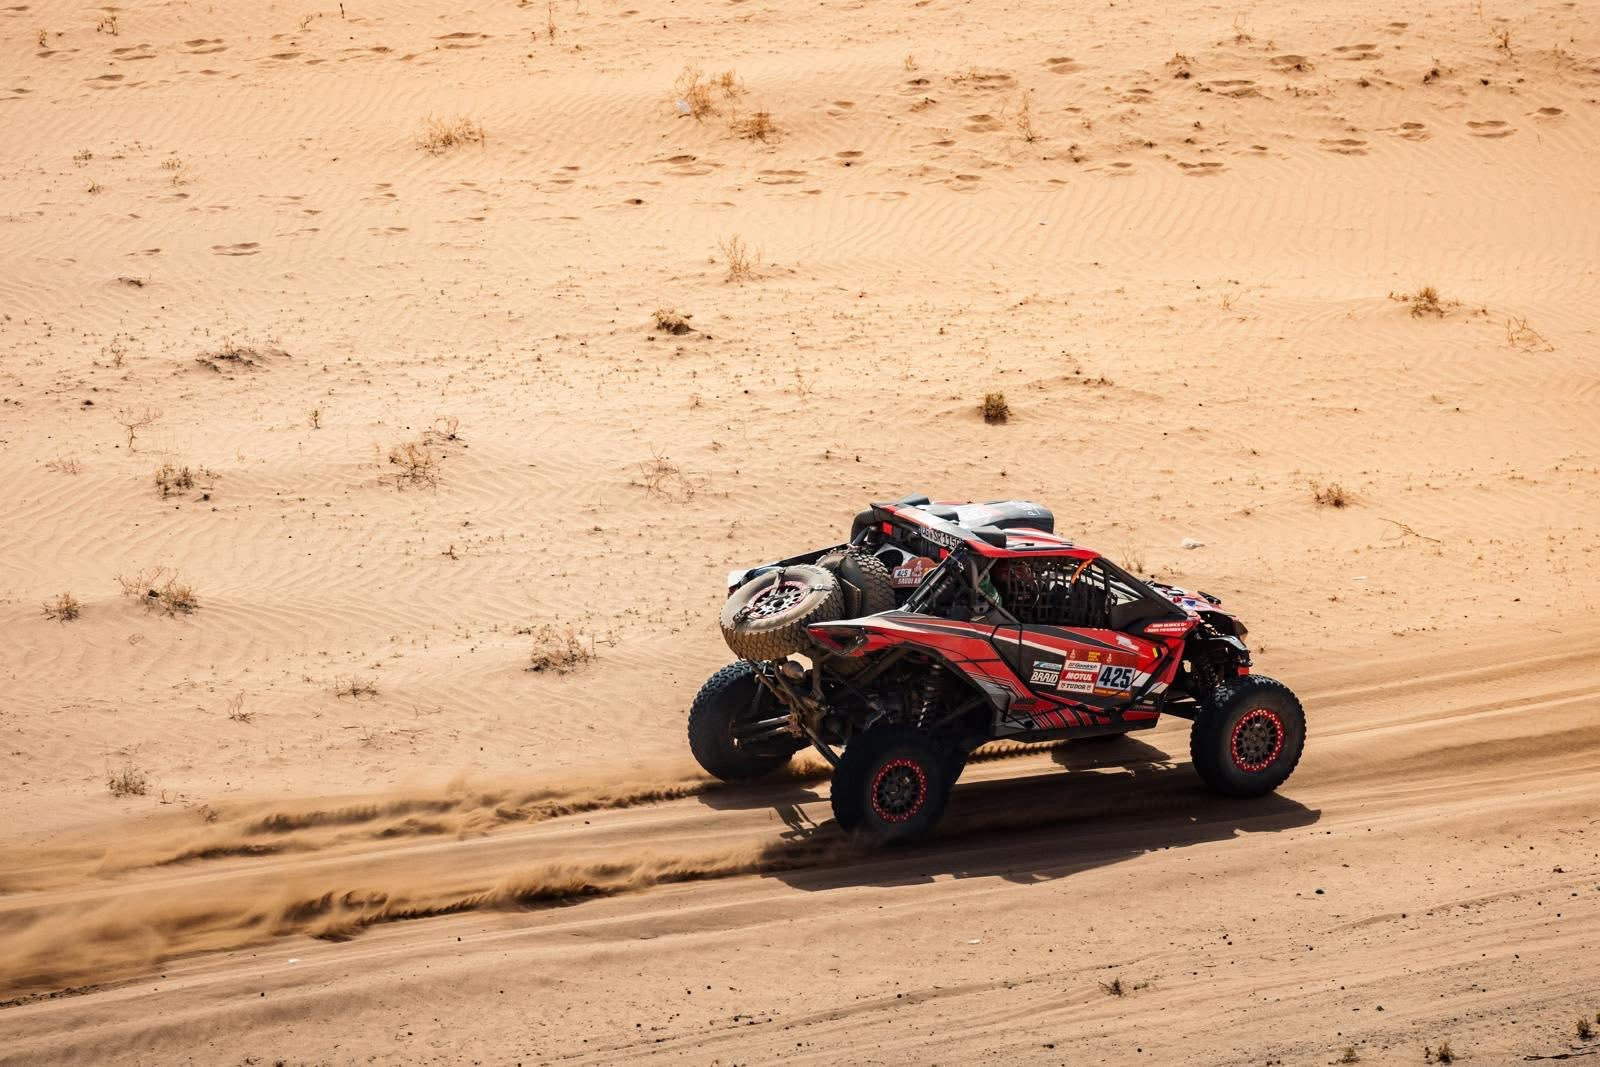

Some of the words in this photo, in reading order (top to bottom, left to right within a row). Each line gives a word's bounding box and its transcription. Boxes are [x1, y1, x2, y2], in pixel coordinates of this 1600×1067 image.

[1031, 671, 1058, 684] BRAID
[1066, 672, 1093, 681] MOTUL
[1099, 666, 1132, 688] 425
